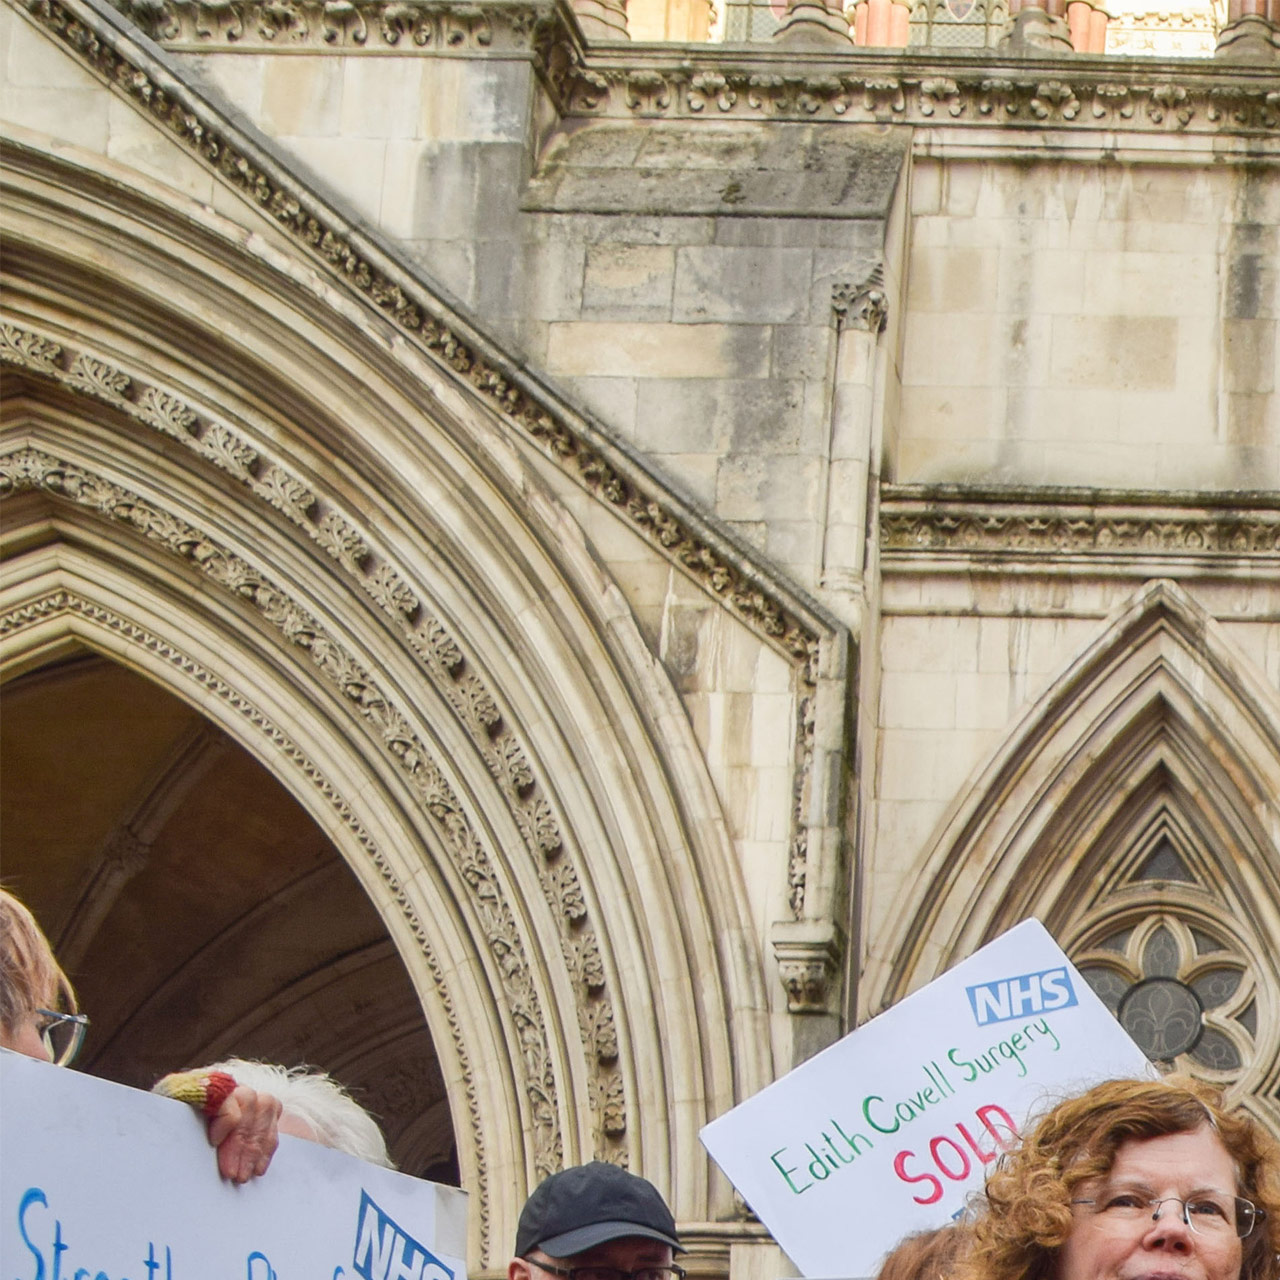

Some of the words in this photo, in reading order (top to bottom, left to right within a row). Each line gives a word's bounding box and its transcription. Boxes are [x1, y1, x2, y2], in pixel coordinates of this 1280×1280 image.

[972, 969, 1072, 1025] NHS
[770, 1119, 874, 1195] Edith
[862, 1060, 956, 1134] Cavell
[948, 1017, 1061, 1083] Surgery
[893, 1103, 1022, 1205] SOLD
